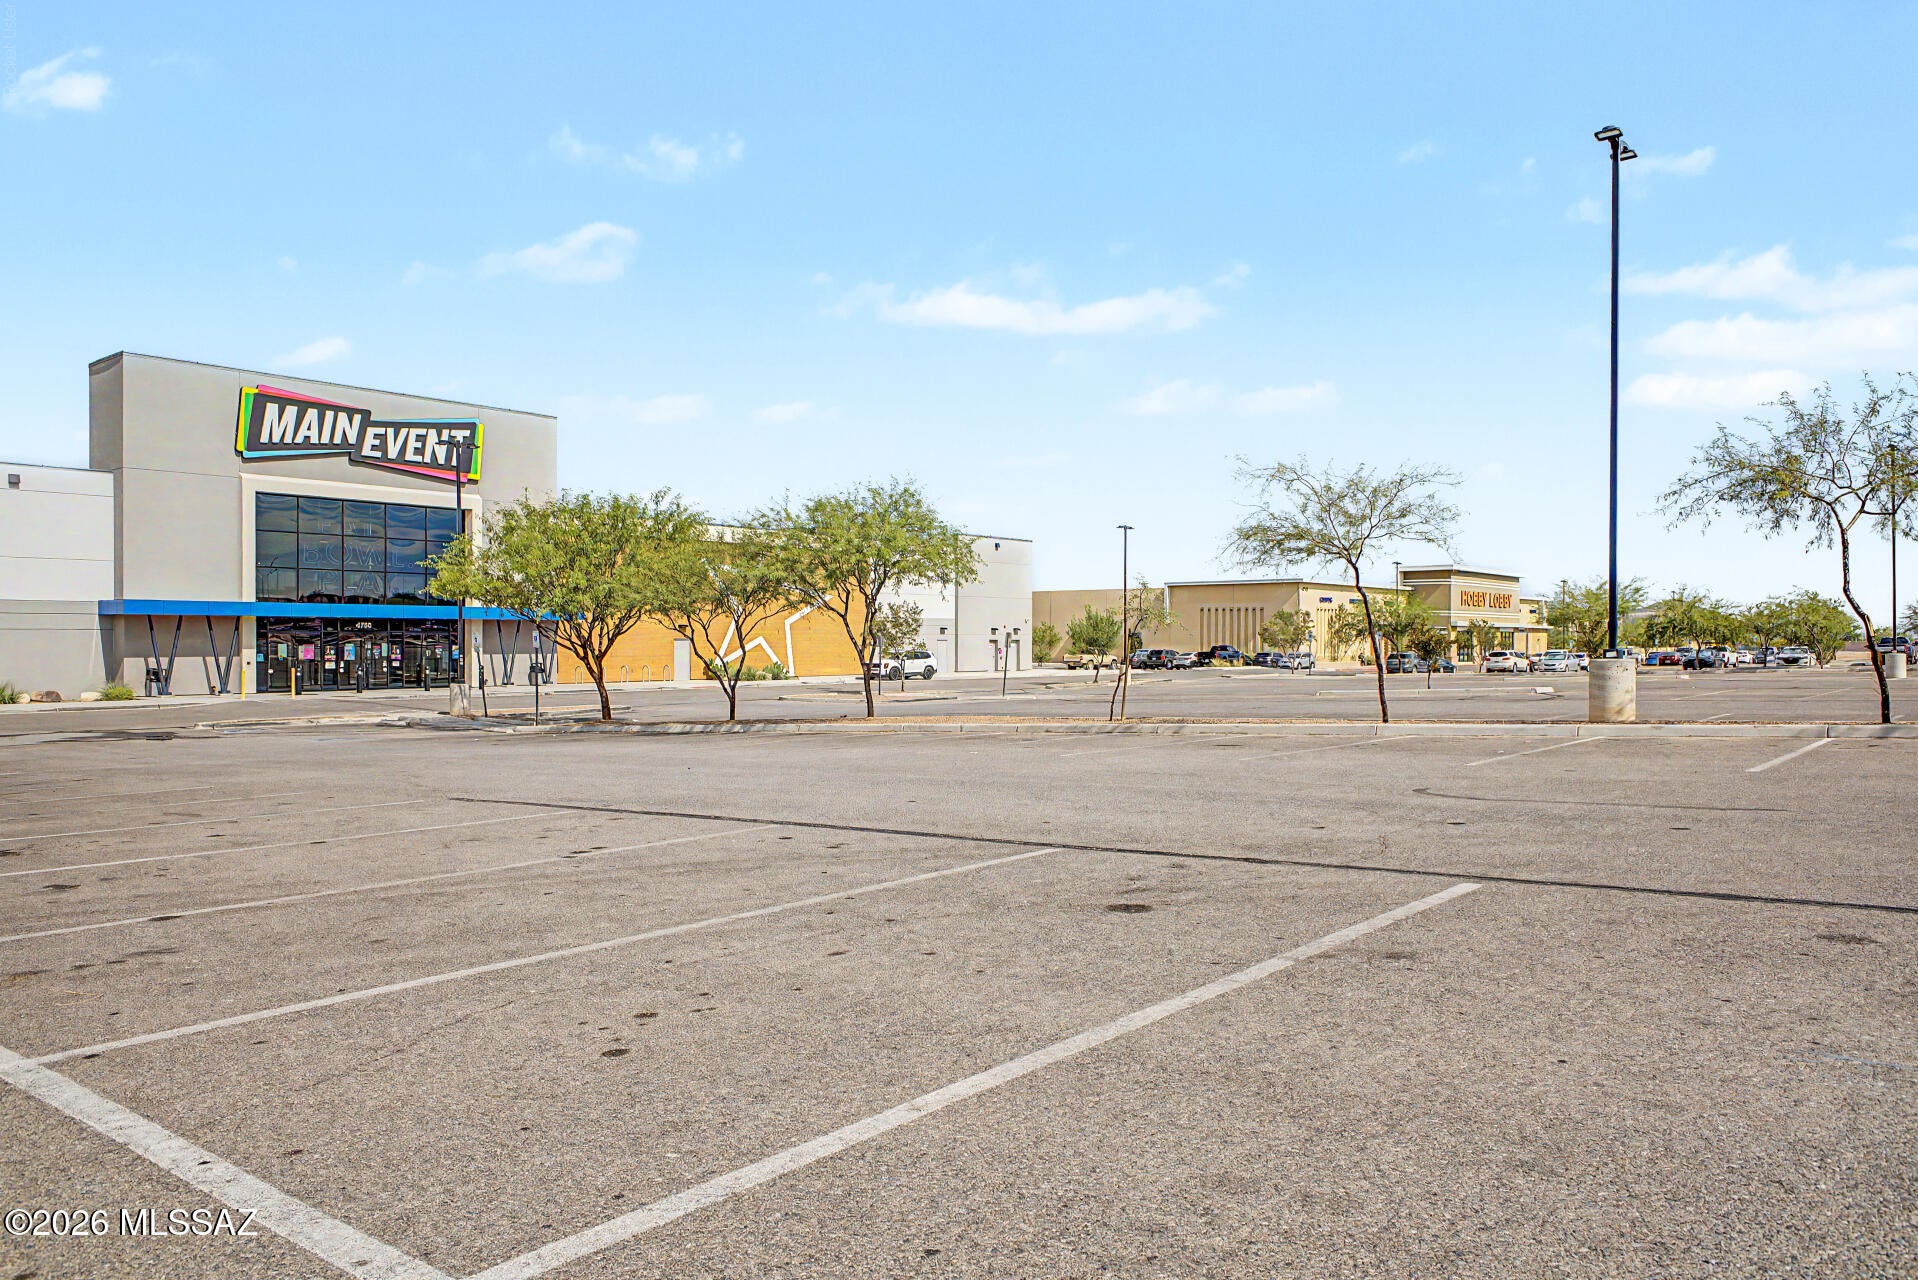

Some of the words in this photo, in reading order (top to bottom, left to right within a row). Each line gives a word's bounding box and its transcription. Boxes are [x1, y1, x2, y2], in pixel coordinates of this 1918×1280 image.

[260, 402, 362, 445] MAIN
[361, 426, 471, 467] EVENT
[1460, 590, 1488, 608] HOBBY
[1489, 592, 1512, 609] LOBBY
